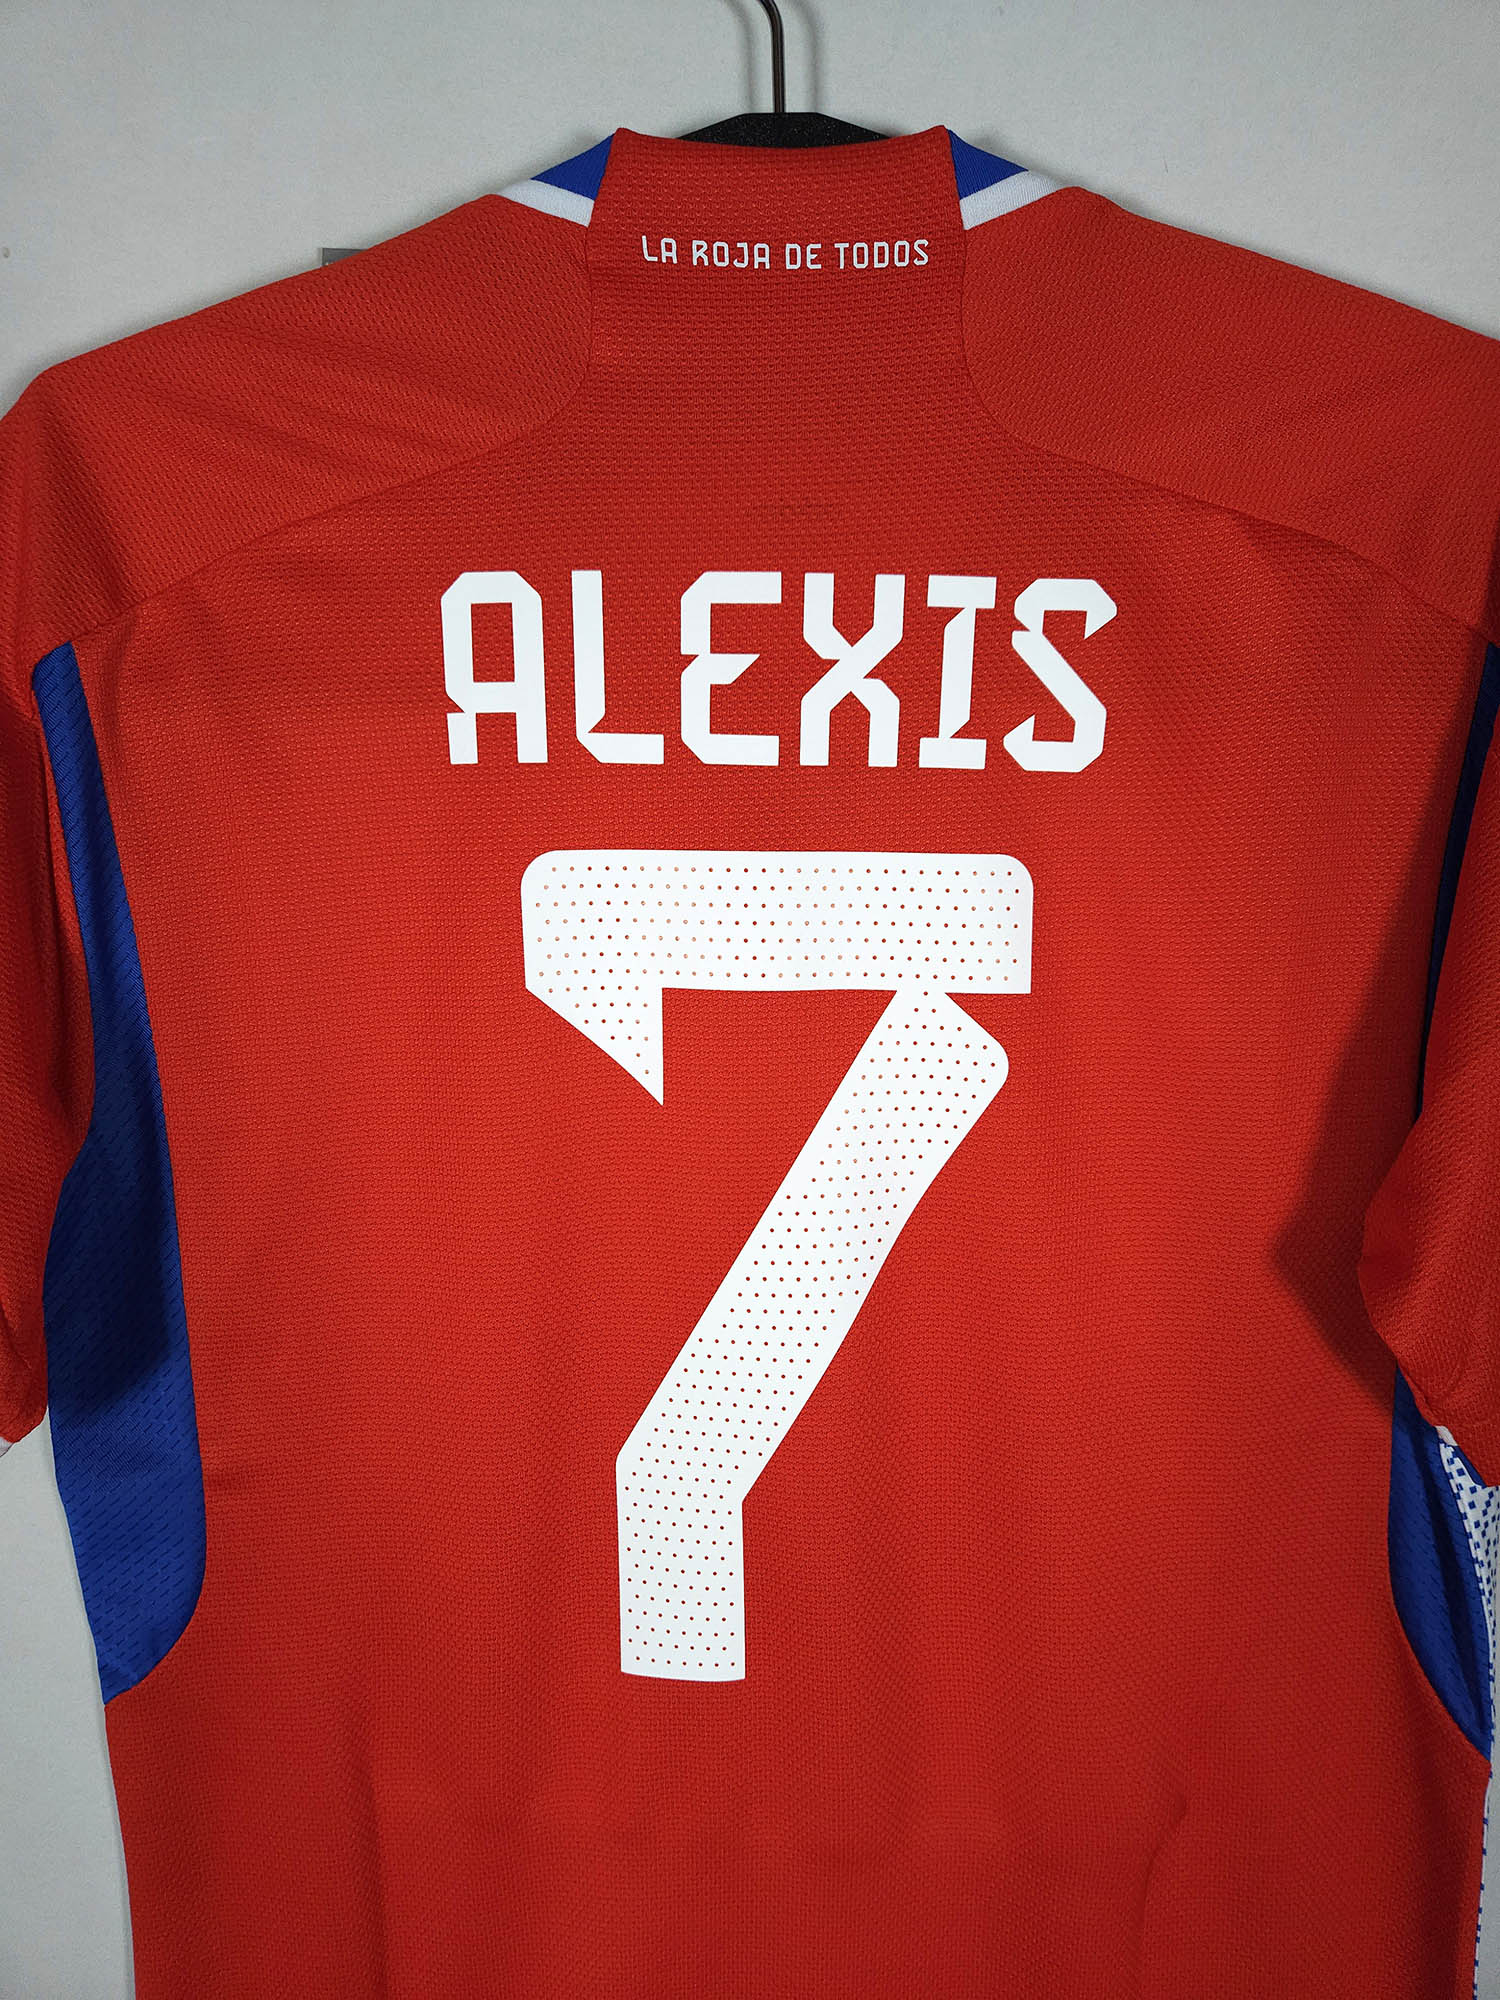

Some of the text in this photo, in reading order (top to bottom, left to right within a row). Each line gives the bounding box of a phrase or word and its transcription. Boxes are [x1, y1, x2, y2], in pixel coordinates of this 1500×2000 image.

[641, 235, 929, 270] LA ROJA DE TODOS
[440, 570, 1118, 773] ALEXIS
[521, 849, 1033, 1682] 7
